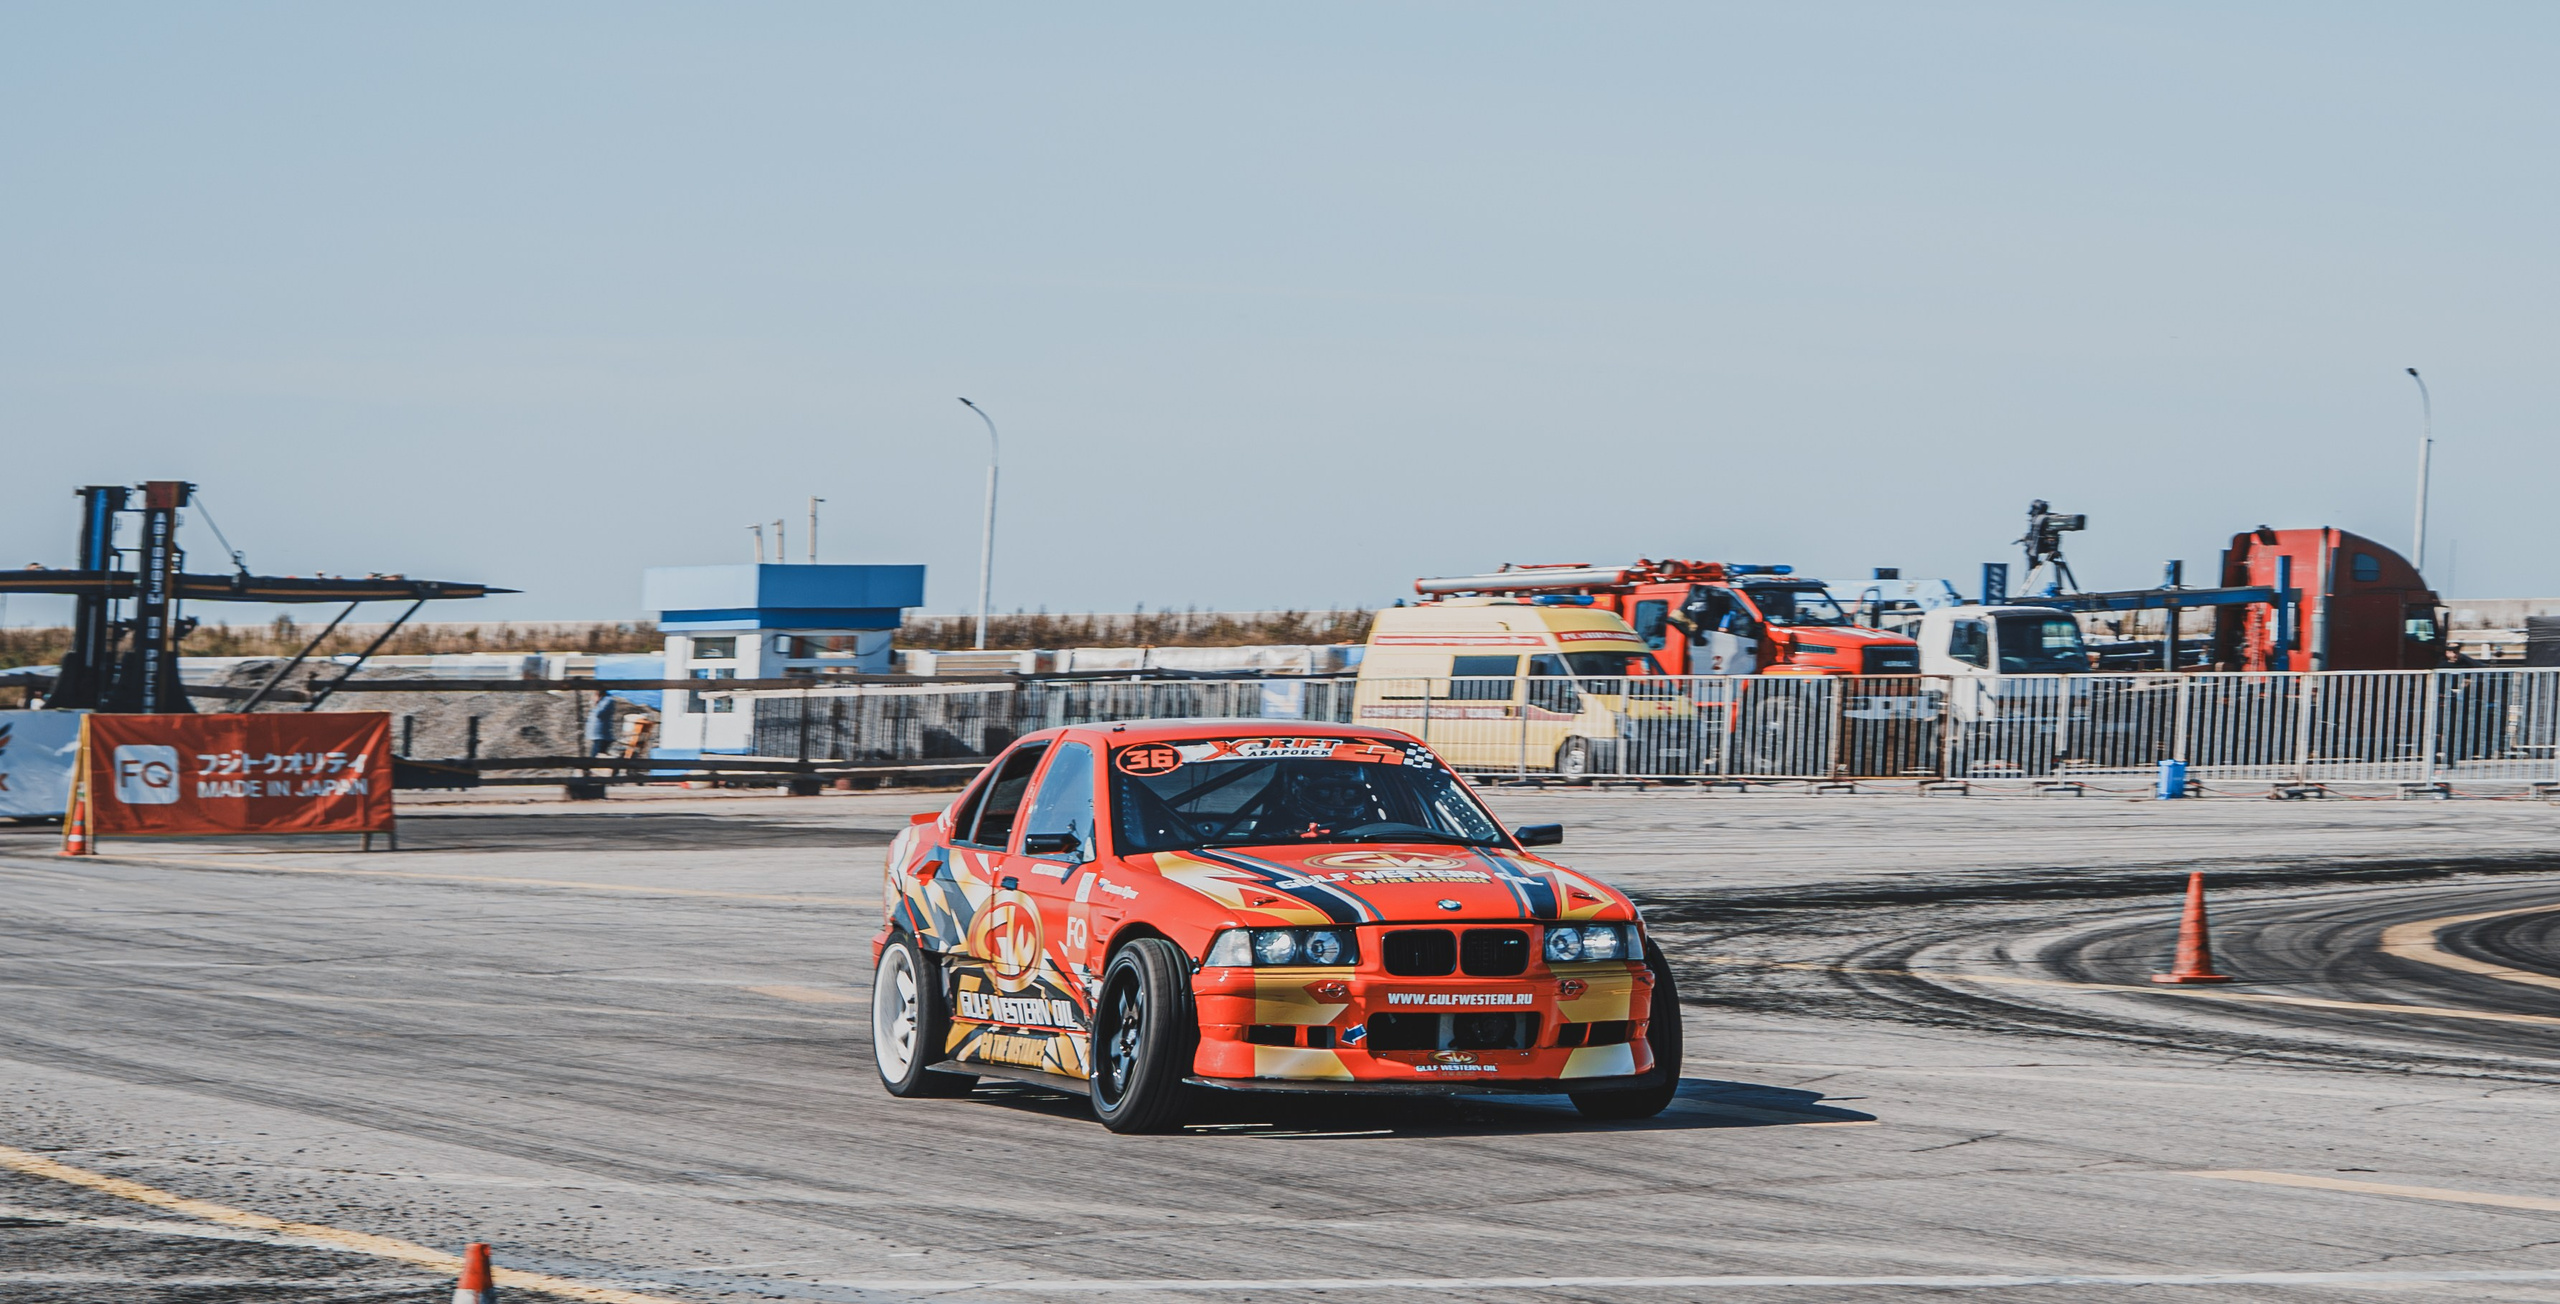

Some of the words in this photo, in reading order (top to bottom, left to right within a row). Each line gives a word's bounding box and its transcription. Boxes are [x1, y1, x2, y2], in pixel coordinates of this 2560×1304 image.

[1126, 748, 1175, 770] 36
[120, 759, 173, 788] FQ
[197, 780, 263, 798] MADE
[266, 780, 291, 797] IN
[295, 778, 369, 797] JAPAN
[1275, 871, 1350, 890] GULF
[1352, 869, 1492, 880] WESTERN
[1494, 871, 1544, 886] OIL
[1066, 916, 1088, 949] FQ
[960, 991, 990, 1020] GULF
[988, 995, 1053, 1026] WESTERN
[1051, 998, 1078, 1029] OIL
[1387, 993, 1533, 1006] WWW.GULFWESTERN.RU
[1415, 1064, 1439, 1072] GULF
[1440, 1064, 1482, 1072] WESTERN
[1483, 1064, 1498, 1072] OIL
